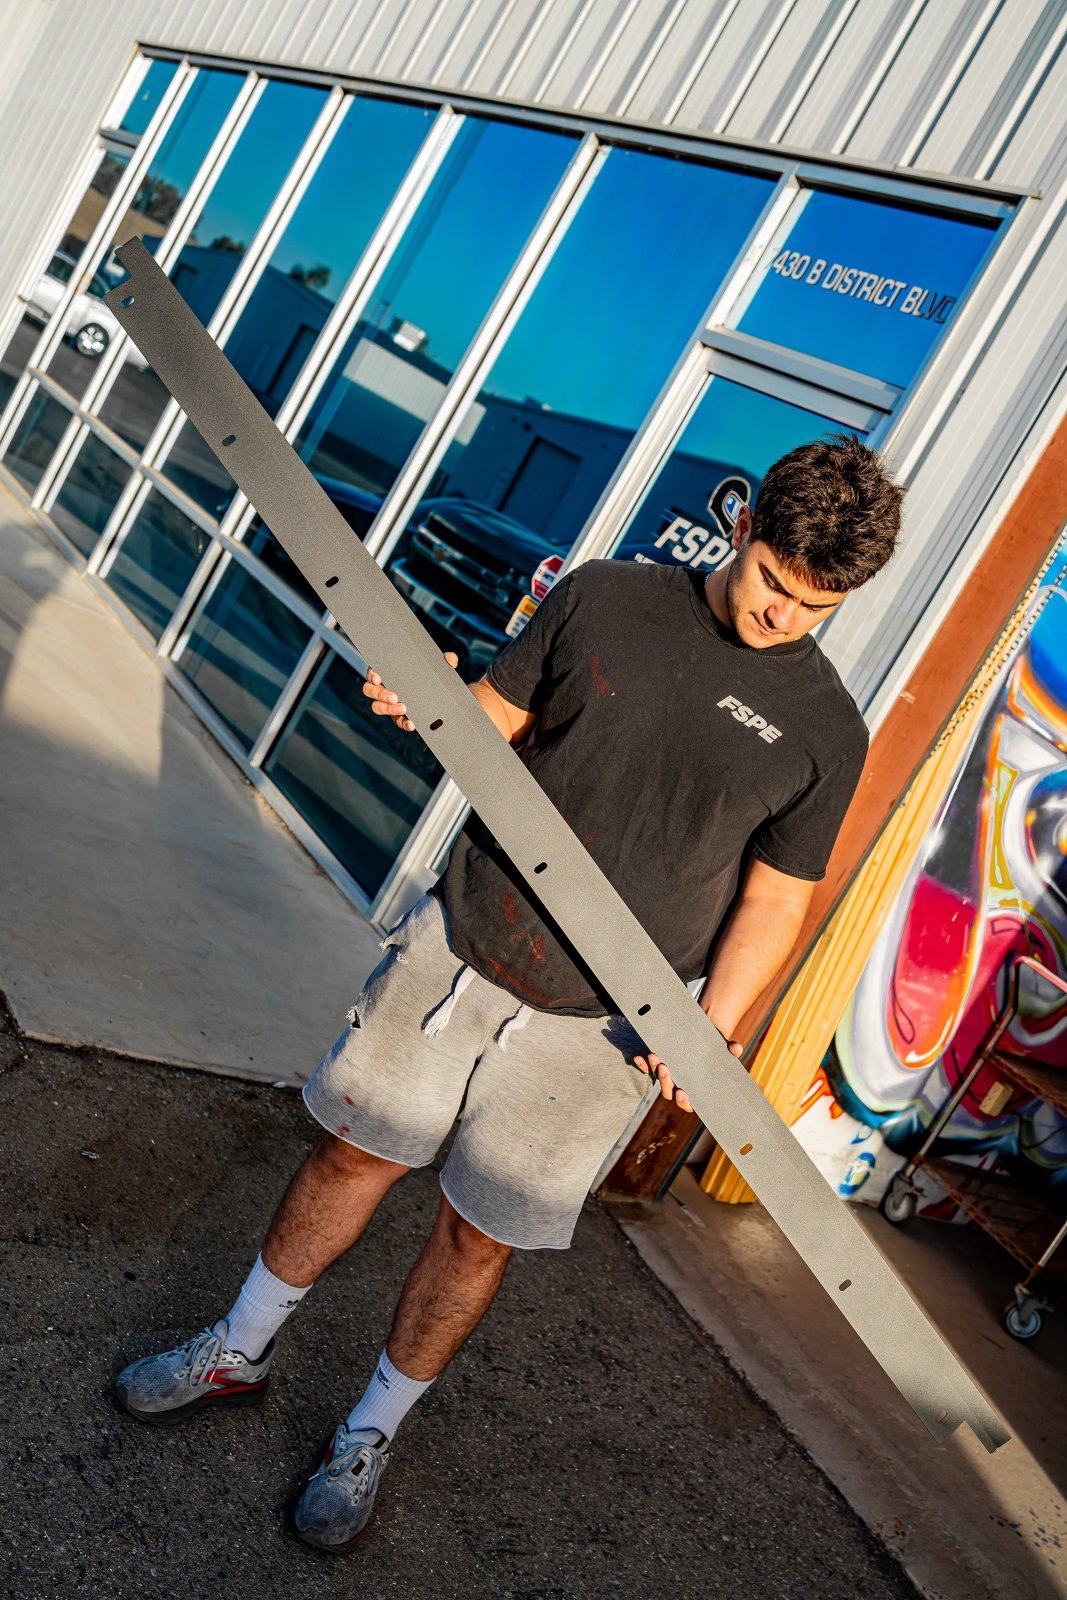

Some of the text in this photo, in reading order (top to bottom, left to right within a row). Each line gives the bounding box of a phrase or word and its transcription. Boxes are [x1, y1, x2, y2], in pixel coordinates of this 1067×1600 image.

[806, 259, 827, 285] B
[822, 264, 908, 308] DISTRICT
[900, 286, 957, 324] BLVD
[716, 694, 783, 744] FSPE
